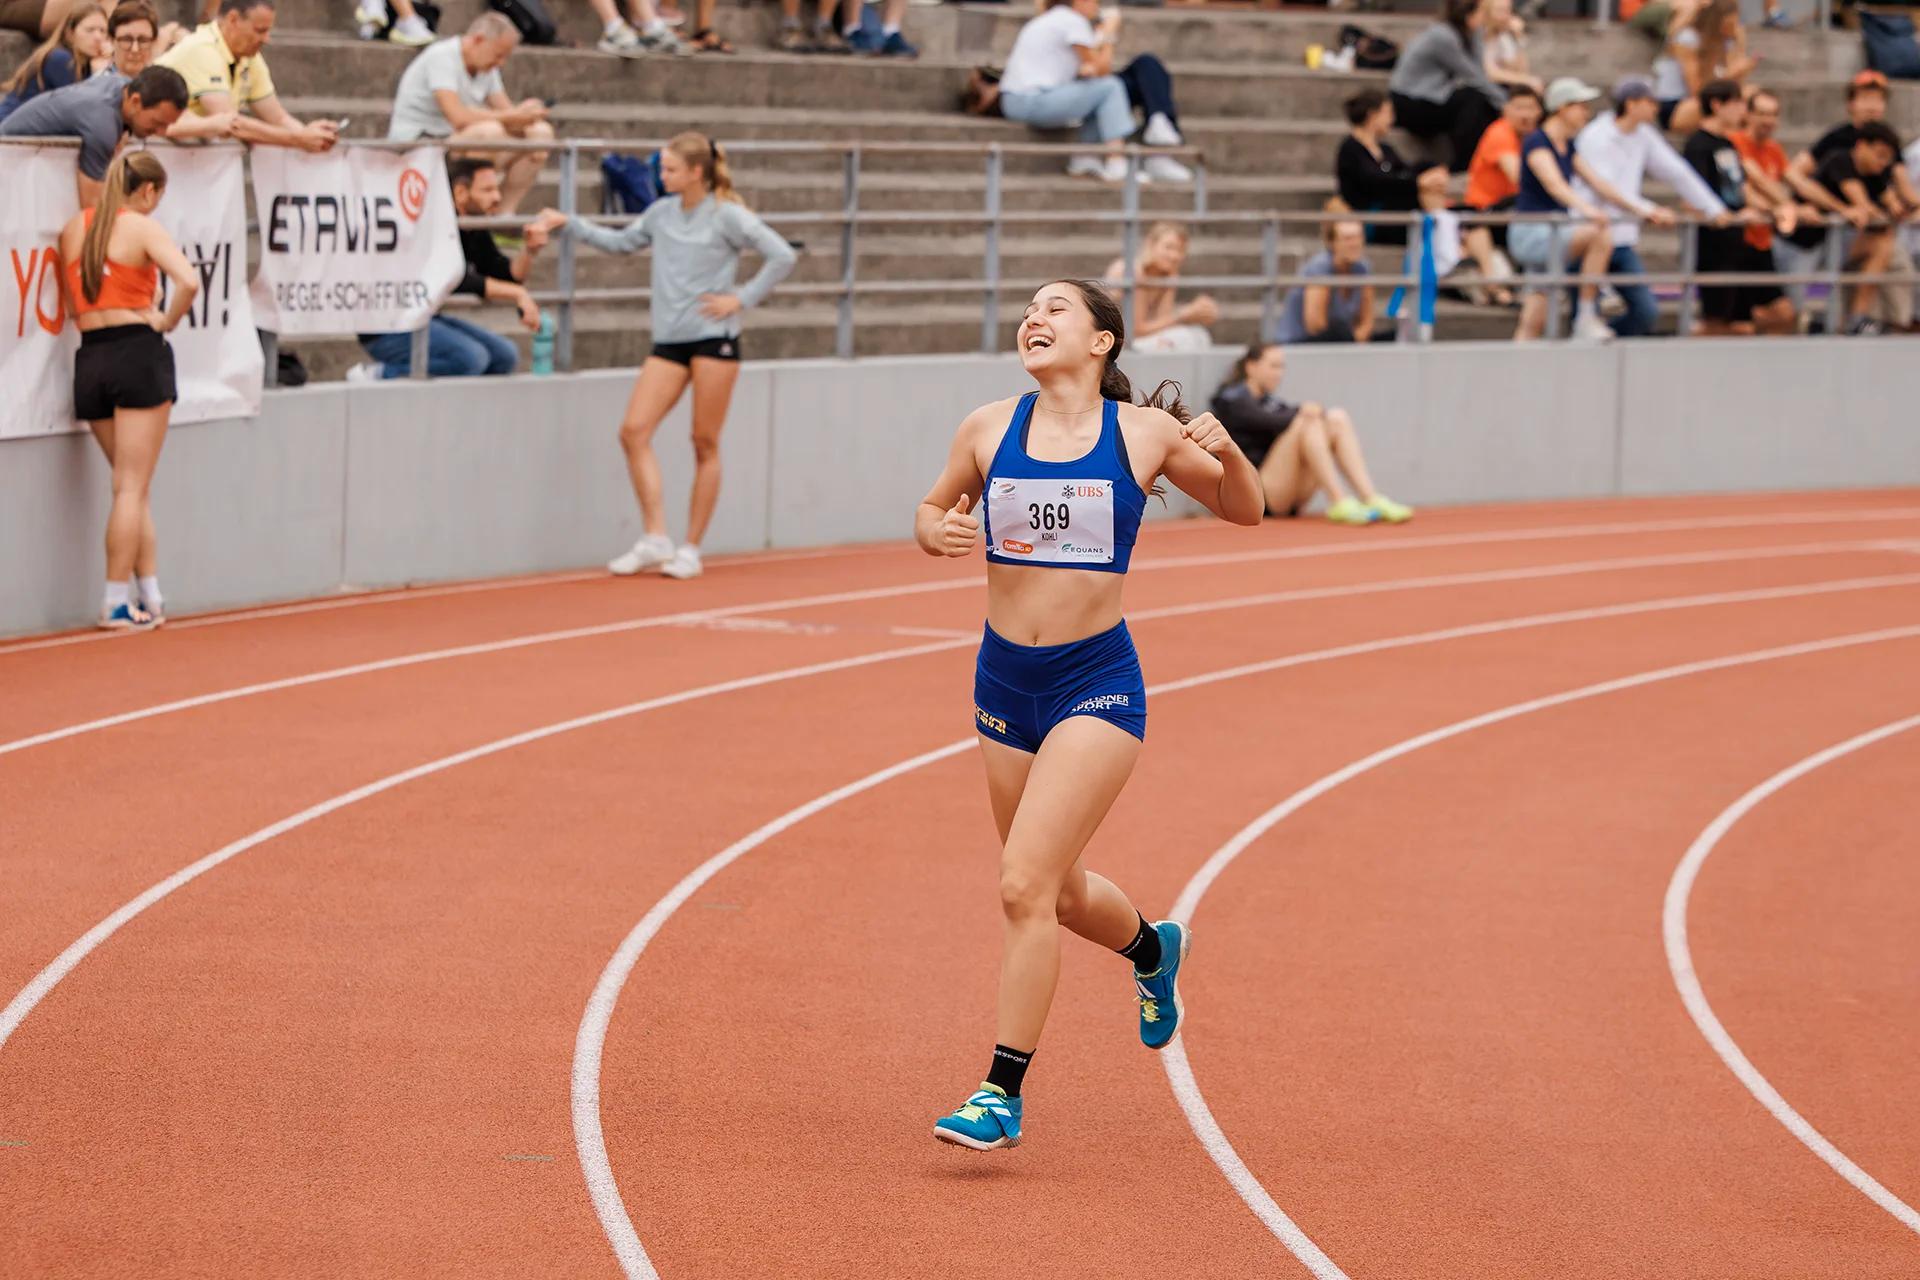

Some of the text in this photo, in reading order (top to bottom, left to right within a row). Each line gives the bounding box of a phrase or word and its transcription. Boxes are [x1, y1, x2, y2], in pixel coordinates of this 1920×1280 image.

[269, 194, 398, 253] ETAVIS
[11, 245, 67, 337] YO
[1077, 486, 1103, 497] UBS
[1028, 503, 1070, 530] 369
